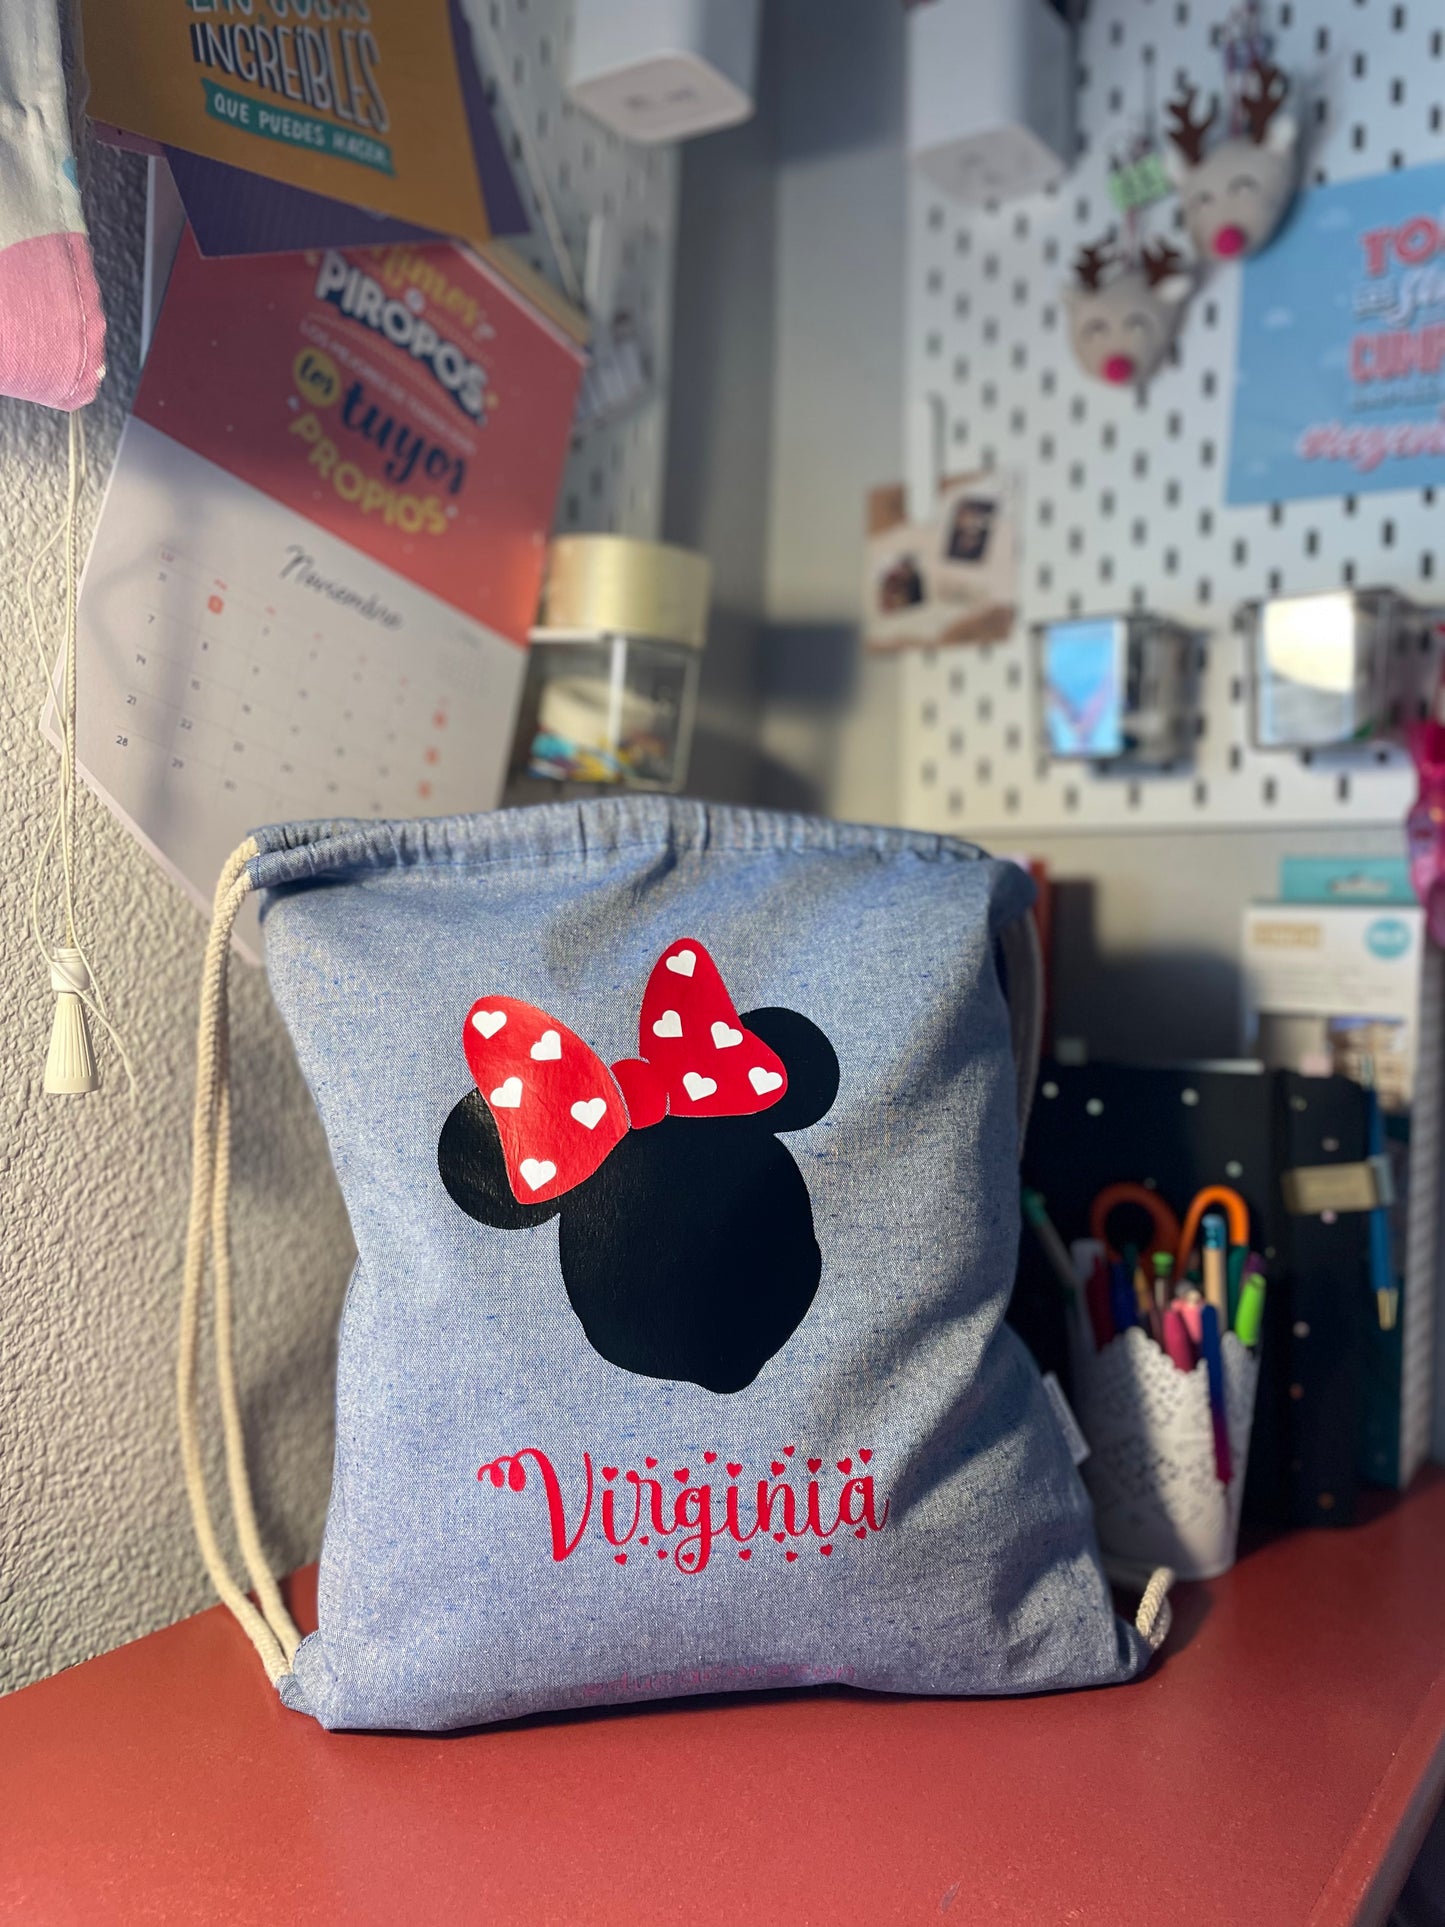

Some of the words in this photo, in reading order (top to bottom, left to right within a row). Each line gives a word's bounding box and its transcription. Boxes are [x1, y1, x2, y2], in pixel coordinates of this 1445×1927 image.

[214, 92, 250, 124] QUE
[258, 110, 325, 147] PUEDES
[289, 412, 447, 535] PROPIOS
[126, 693, 137, 706] 21
[115, 734, 129, 748] 28
[478, 1446, 890, 1575] Virginia
